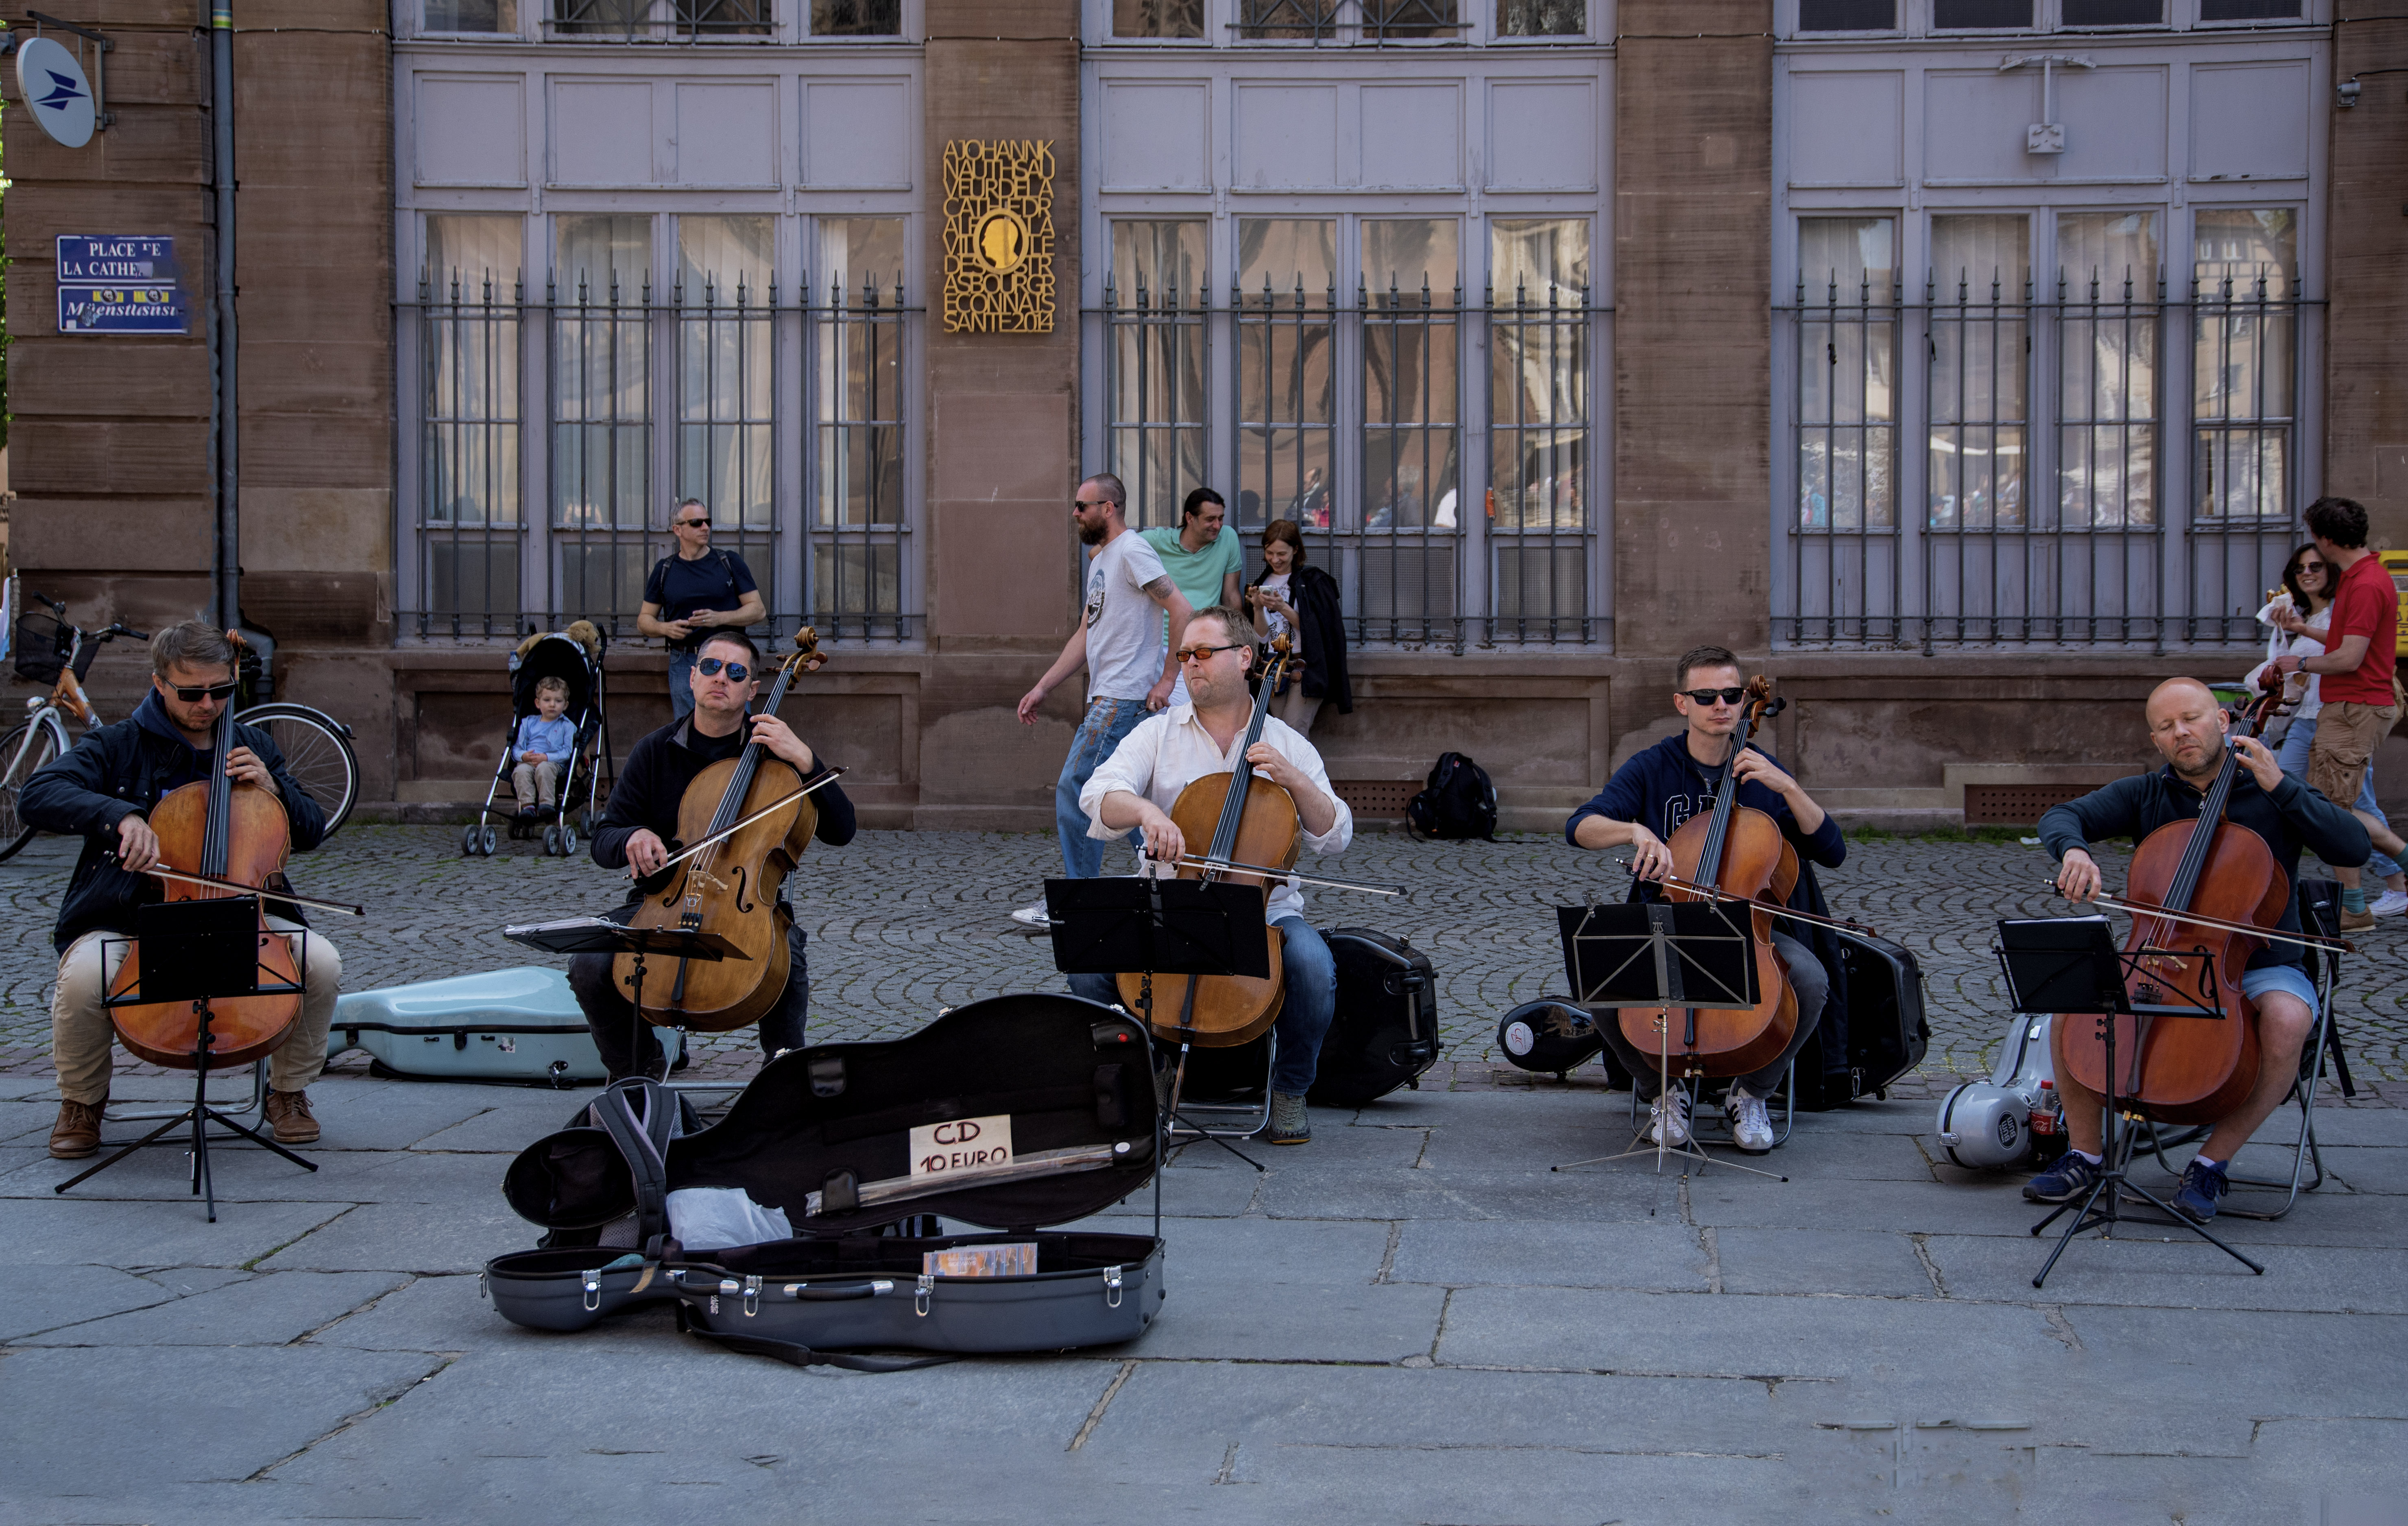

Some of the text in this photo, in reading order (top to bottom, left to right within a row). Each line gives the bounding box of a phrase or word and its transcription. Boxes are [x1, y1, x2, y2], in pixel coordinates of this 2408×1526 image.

[89, 242, 136, 257] PLACE
[63, 261, 83, 276] LA
[934, 1121, 981, 1145] CD
[2001, 1120, 2010, 1142] BUM
[2007, 1116, 2016, 1138] BUM
[920, 1146, 1008, 1172] 10 EURO
